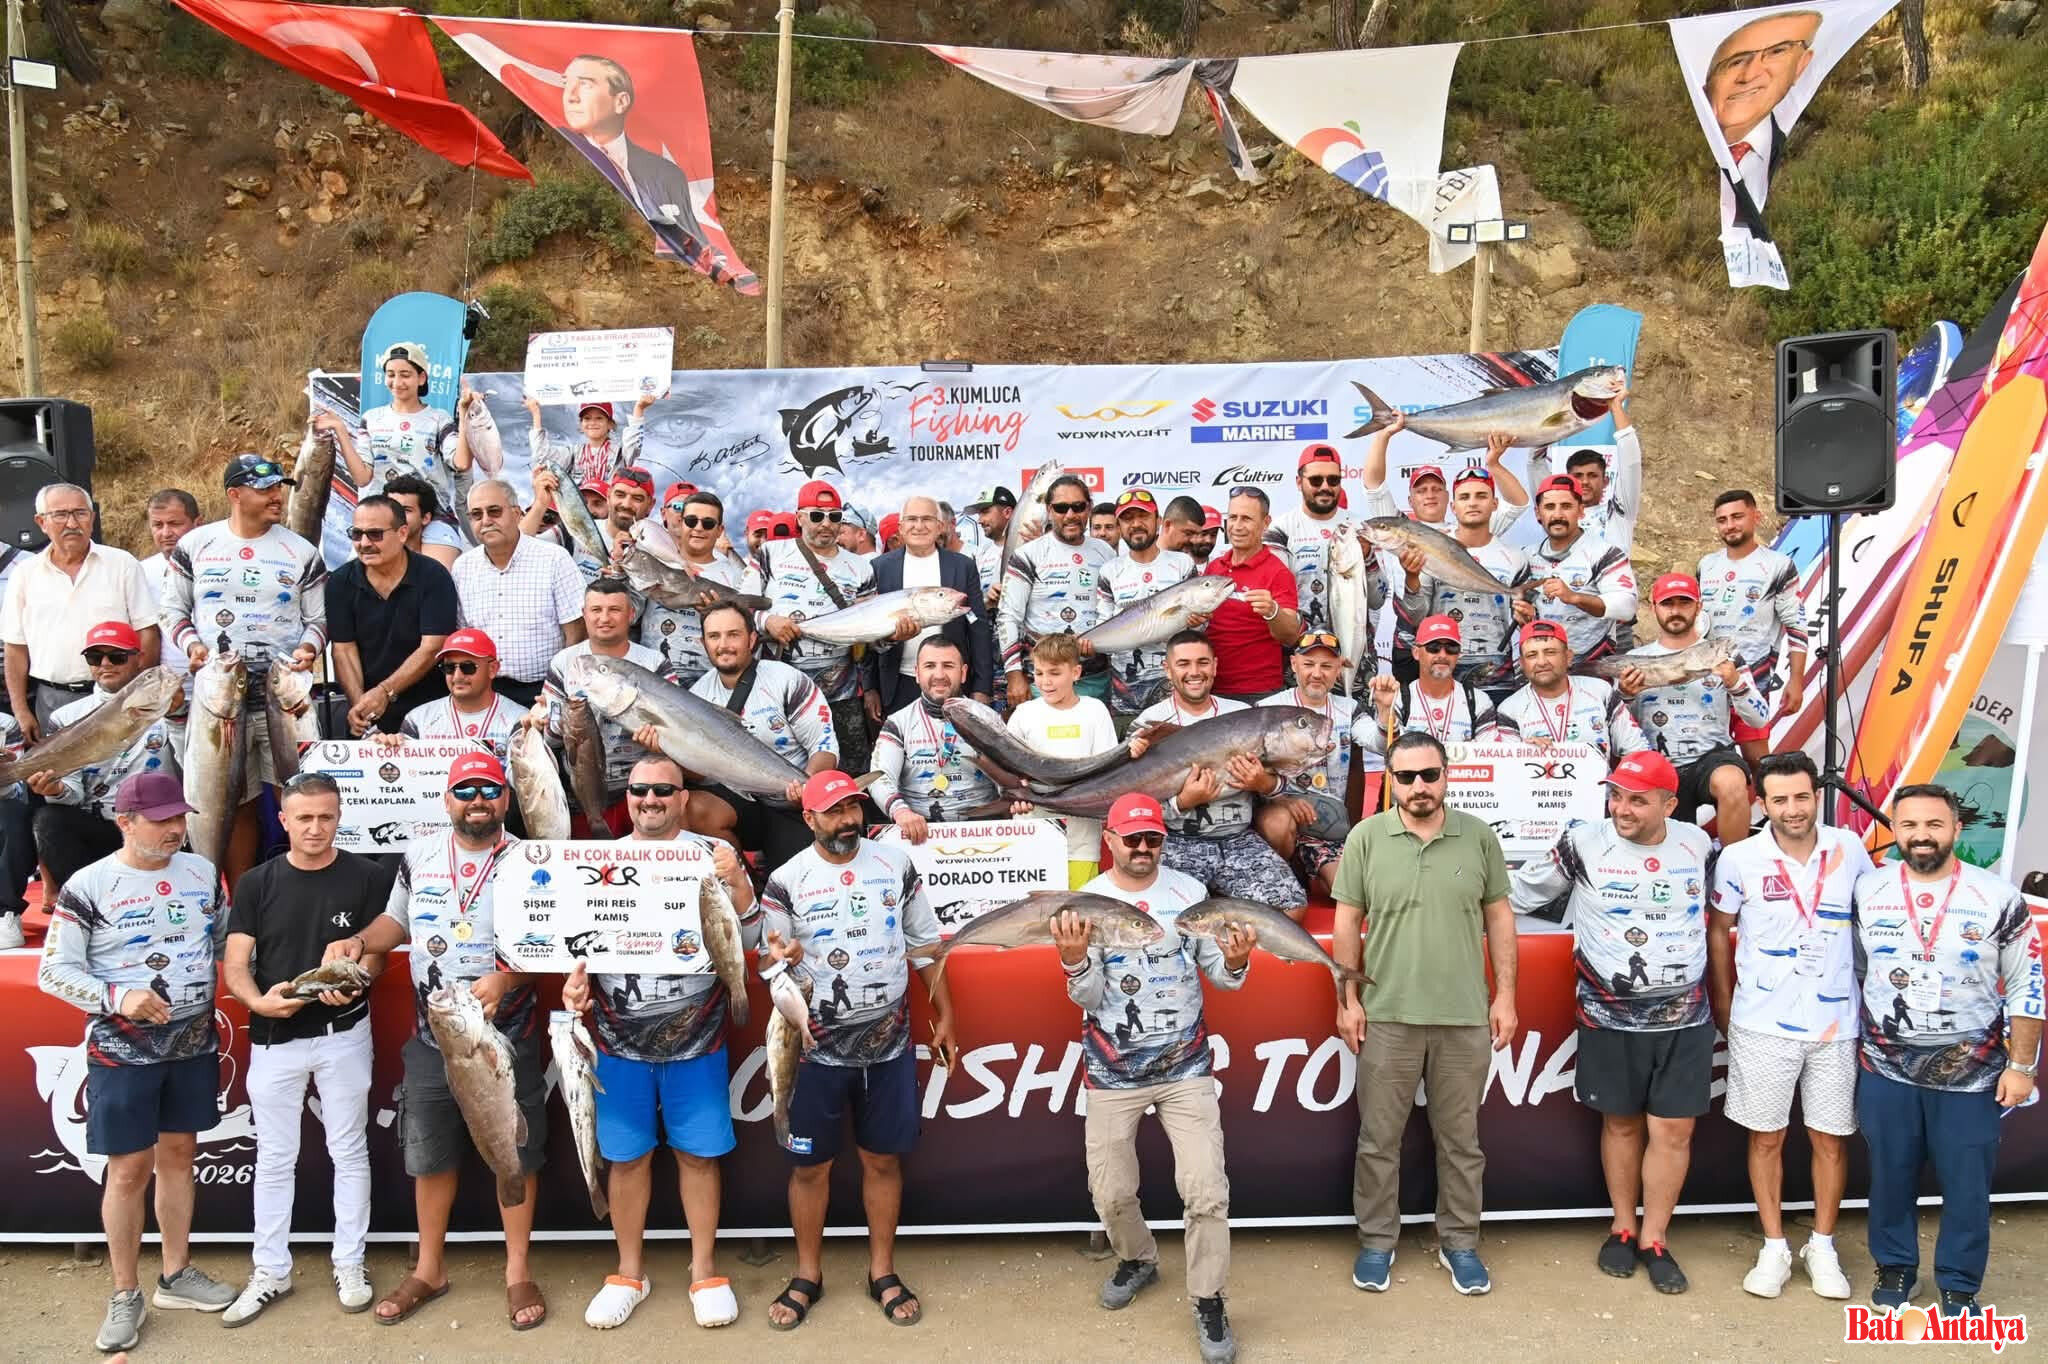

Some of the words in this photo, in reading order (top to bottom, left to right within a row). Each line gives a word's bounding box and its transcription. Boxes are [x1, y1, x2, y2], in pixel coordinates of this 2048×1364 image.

[1222, 399, 1328, 418] SUZUKI
[909, 394, 1030, 452] Fishing
[1057, 428, 1172, 440] WOWINYACHT
[1222, 425, 1296, 441] MARINE
[909, 444, 1001, 462] TOURNAMENT
[1141, 471, 1201, 485] OWNER
[235, 595, 256, 603] NERO
[1890, 557, 1959, 696] SHUFA
[358, 747, 374, 758] EN
[404, 747, 436, 758] BALIK
[1473, 748, 1513, 758] YAKALA
[1516, 748, 1546, 758] BIRAK
[961, 826, 993, 838] BALIK
[564, 849, 580, 861] EN
[615, 849, 652, 861] BALIK
[929, 870, 994, 886] DORADO
[998, 869, 1046, 883] TEKNE
[1601, 892, 1639, 900] ERHAN
[523, 899, 556, 909] ŞİŞME
[664, 902, 686, 910] SUP
[529, 914, 550, 922] BOT
[594, 914, 629, 923] KAMIŞ
[806, 911, 839, 923] ERHAN
[117, 918, 155, 930] ERHAN
[164, 934, 185, 943] NERO
[846, 928, 867, 939] NERO
